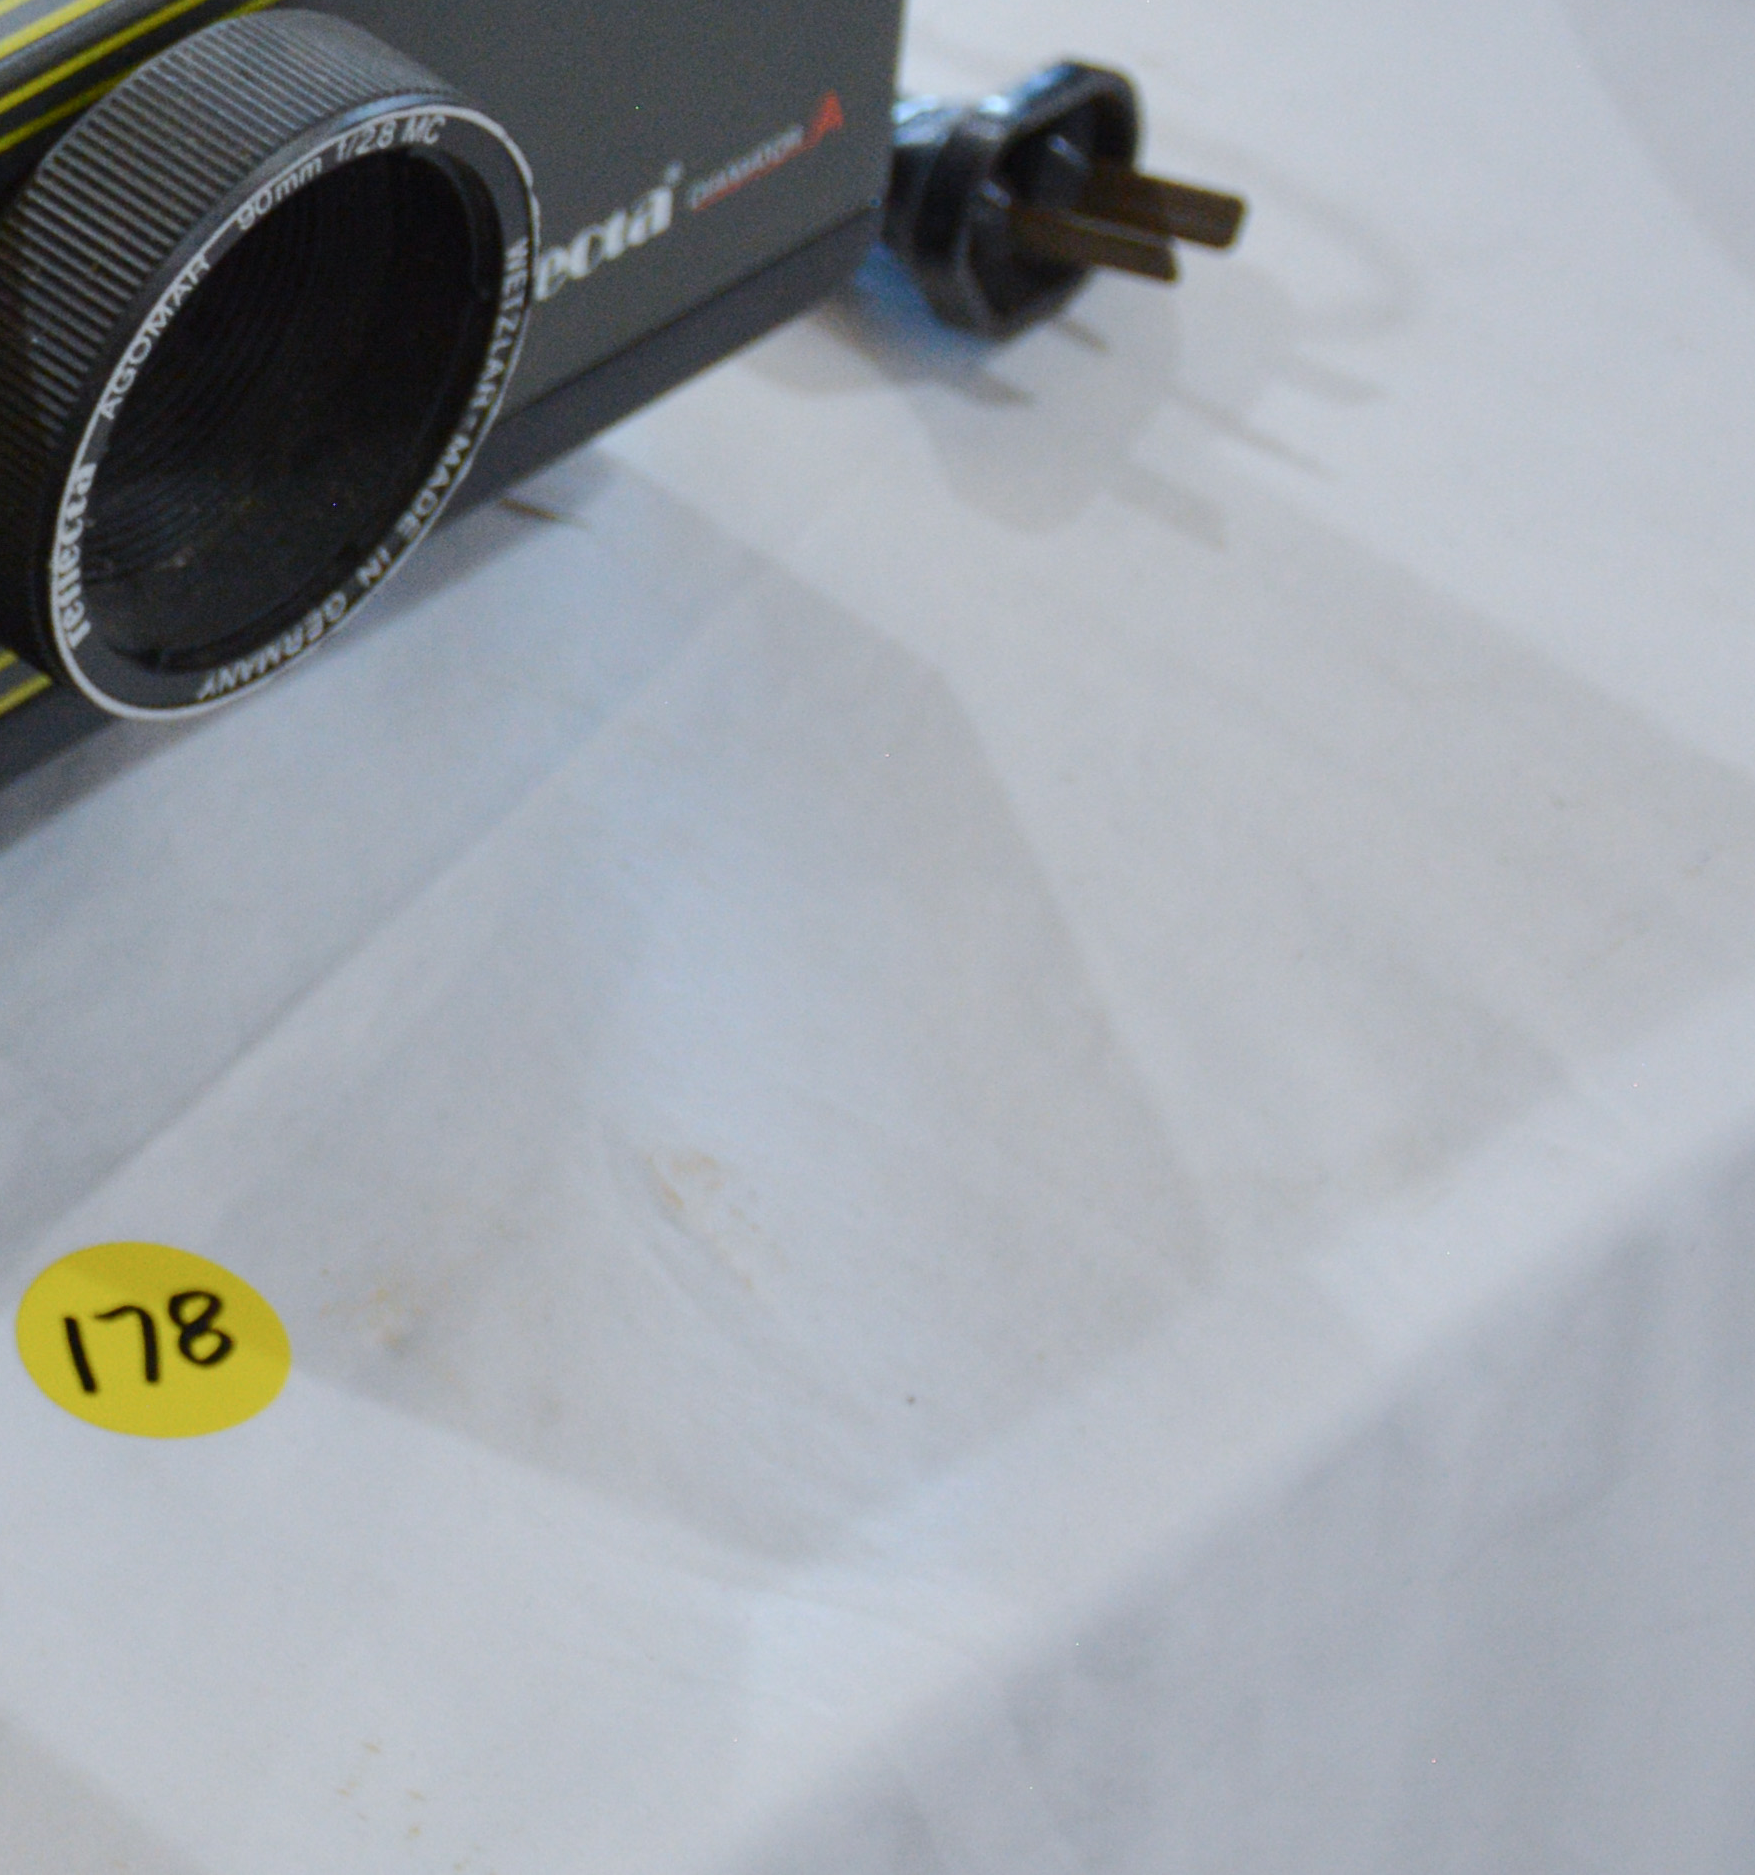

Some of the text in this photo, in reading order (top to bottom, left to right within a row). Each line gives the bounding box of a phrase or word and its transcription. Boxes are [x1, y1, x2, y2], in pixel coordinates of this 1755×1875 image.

[96, 254, 211, 423] AGOMAR
[236, 156, 324, 231] 90mm
[401, 113, 447, 147] MC
[470, 236, 530, 410] WETZLAR
[396, 431, 472, 539] MADE
[355, 544, 392, 589] IN
[196, 590, 350, 703] GERMANY
[63, 1289, 235, 1395] 178
